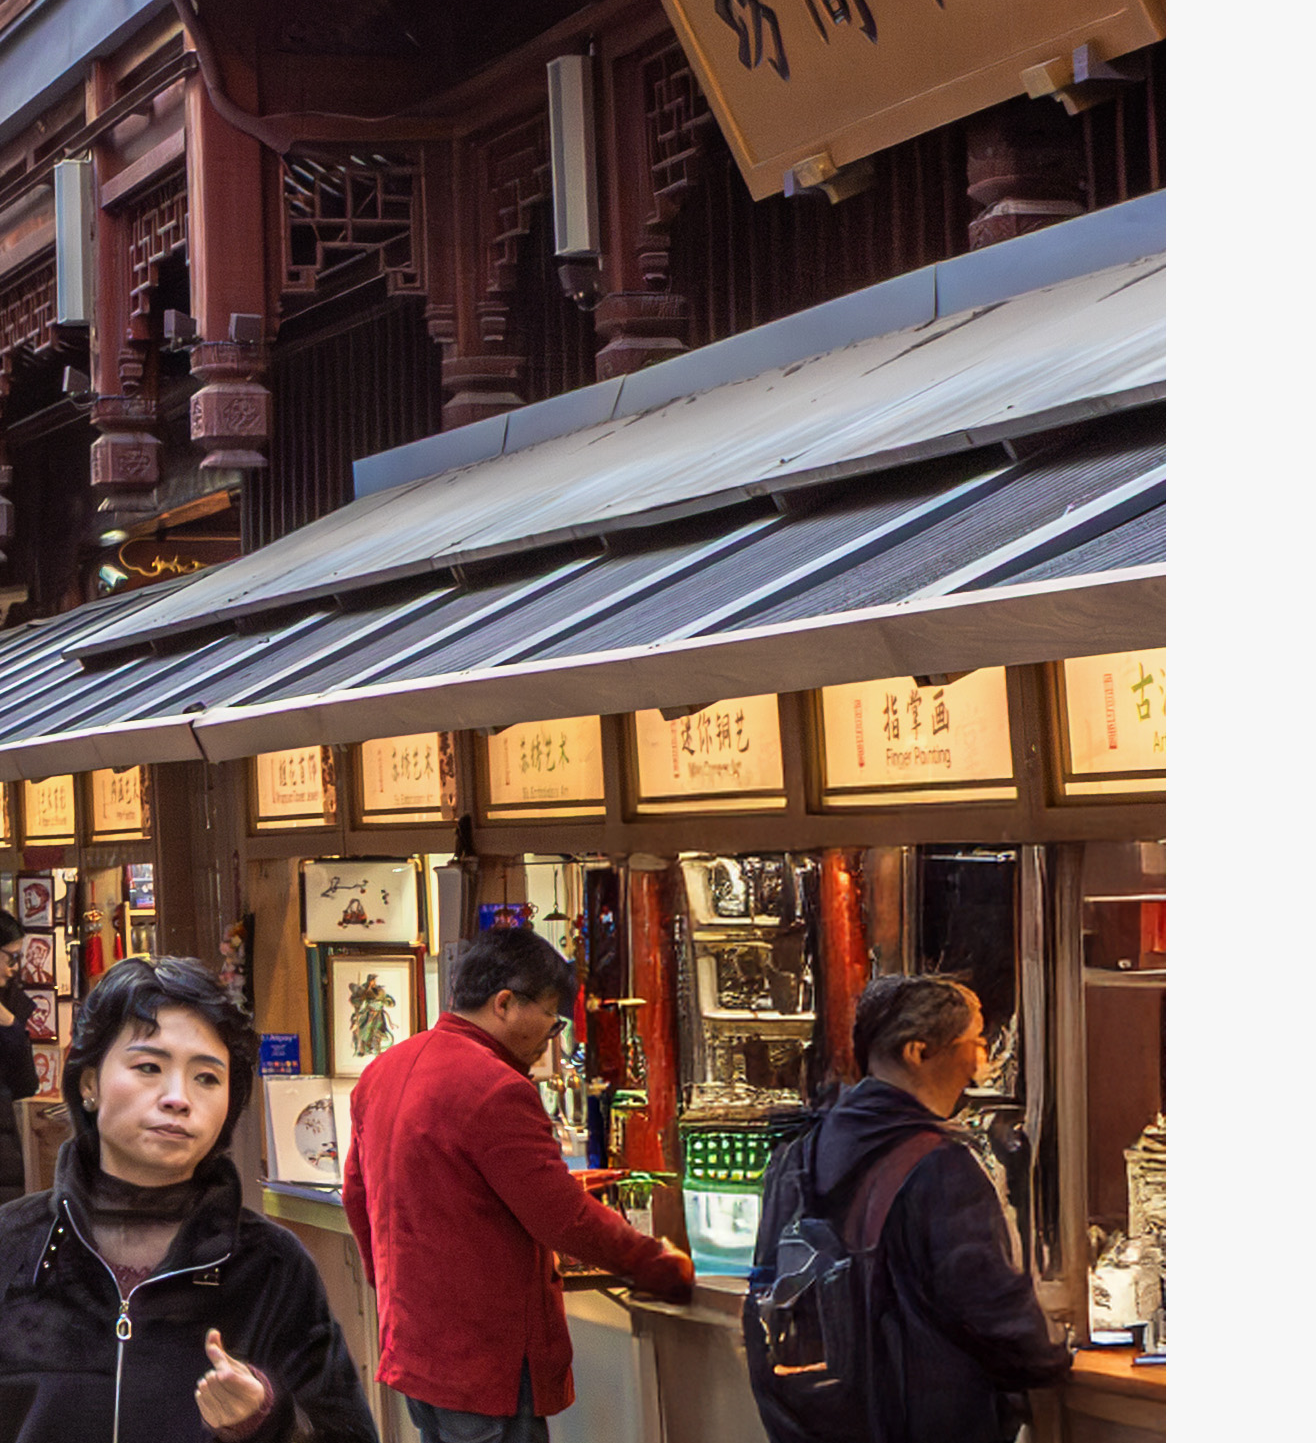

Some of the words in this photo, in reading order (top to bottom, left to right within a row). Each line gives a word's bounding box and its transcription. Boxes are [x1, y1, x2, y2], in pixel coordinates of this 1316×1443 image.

[883, 688, 950, 741] 指掌画
[1131, 661, 1166, 722] 古
[886, 747, 913, 769] Finger
[914, 744, 952, 768] Painting
